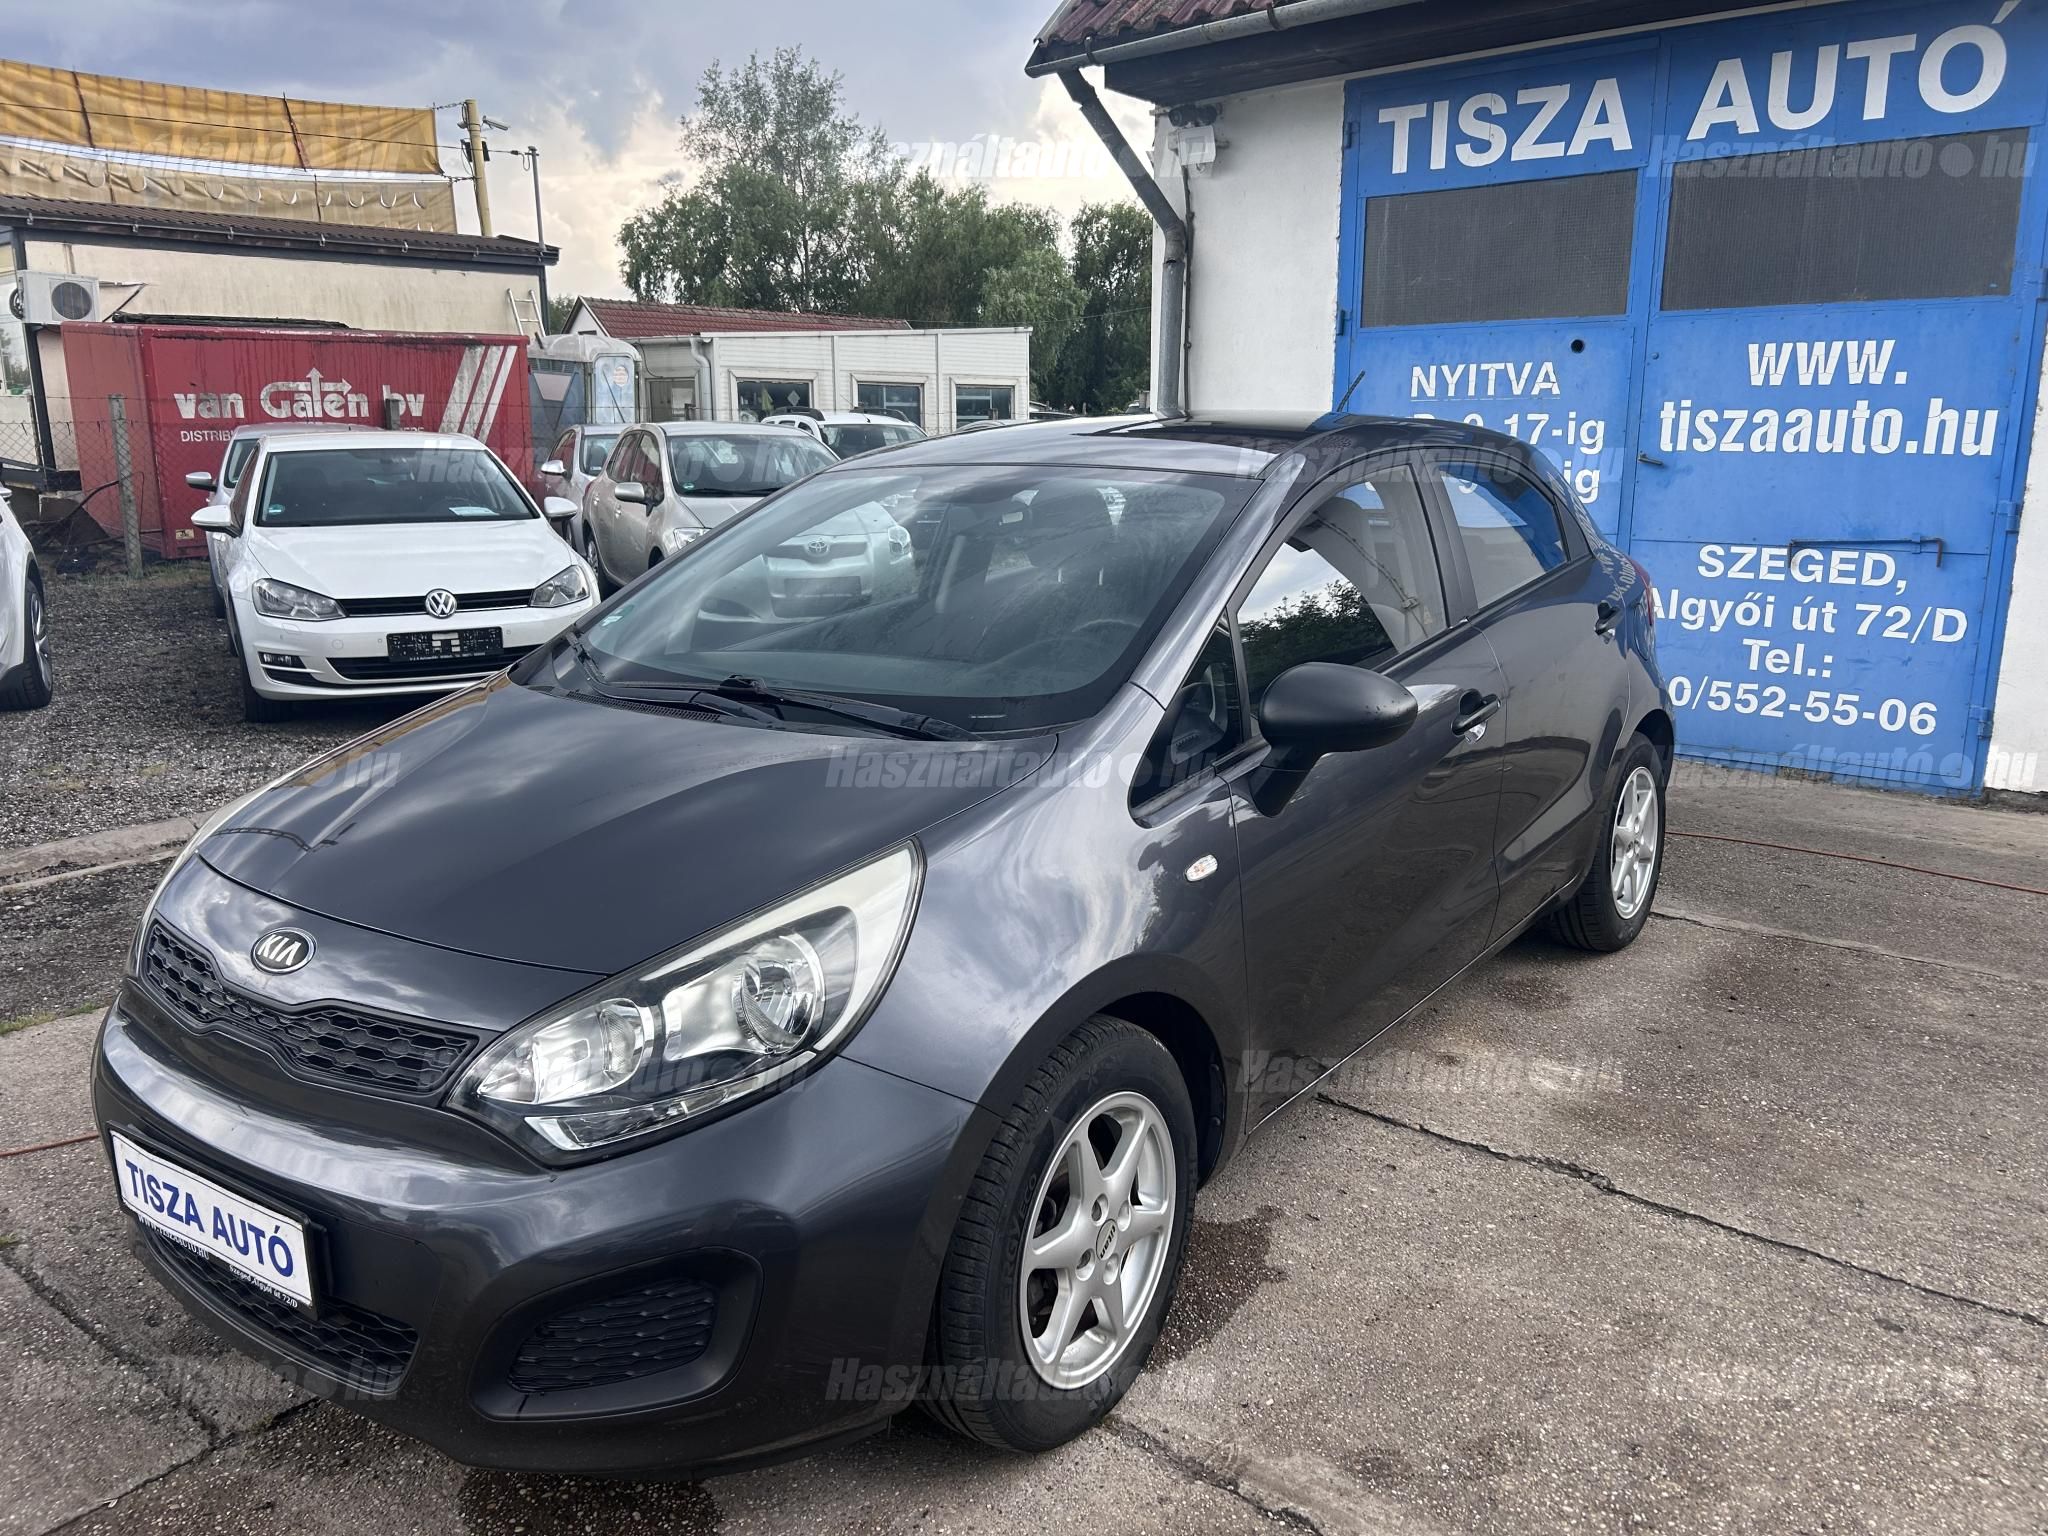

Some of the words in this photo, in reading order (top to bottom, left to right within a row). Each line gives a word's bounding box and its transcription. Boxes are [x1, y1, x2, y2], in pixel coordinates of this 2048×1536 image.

[1379, 77, 1633, 175] TISZA
[1687, 0, 2022, 140] AUTÓ
[1410, 361, 1560, 398] NYITVA
[1748, 339, 1908, 388] www.
[174, 392, 245, 419] van
[260, 367, 369, 419] Galen
[181, 430, 236, 442] DISTRIB
[1659, 399, 1998, 457] tiszaauto.hu
[1697, 544, 1908, 597] SZEGED,
[1652, 587, 1776, 633] Algyői
[1792, 596, 1838, 634] út
[1855, 603, 1968, 644] 72/D
[1743, 638, 1833, 678] Tel.:
[1668, 675, 1938, 736] 0/552-55-06
[257, 934, 301, 966] KIA
[125, 1158, 205, 1233] TISZA
[212, 1205, 294, 1278] AUTÓ
